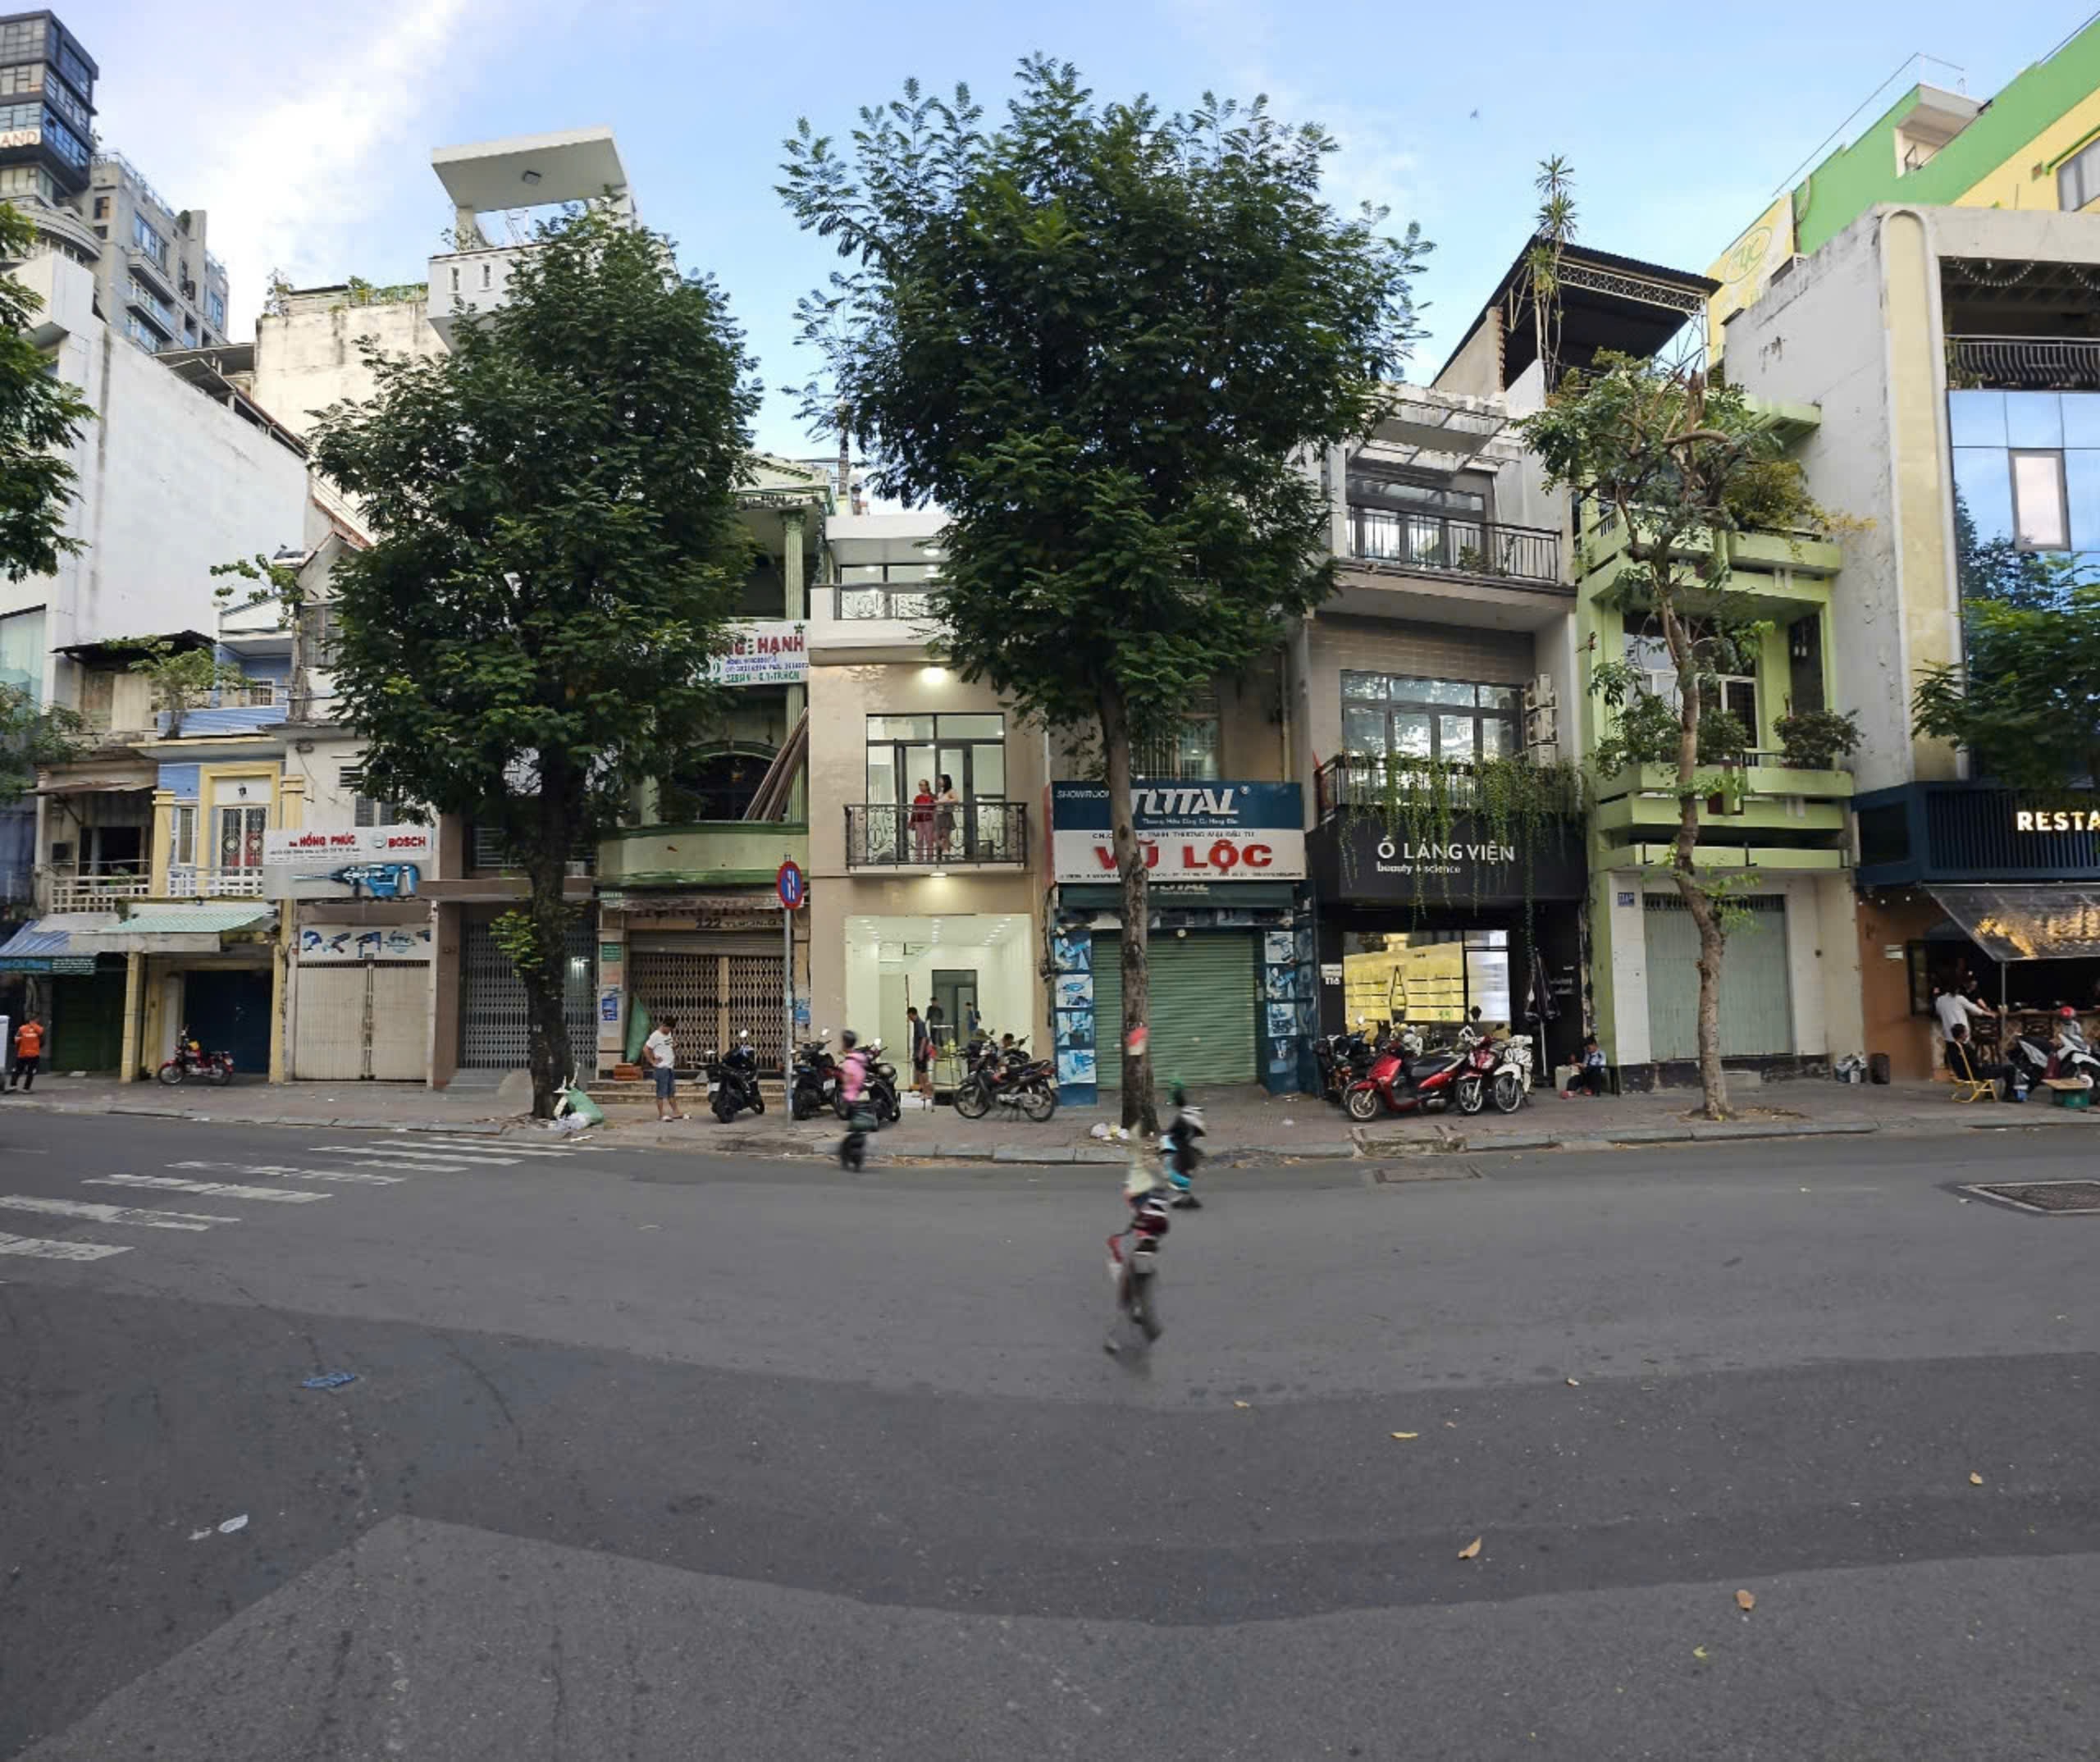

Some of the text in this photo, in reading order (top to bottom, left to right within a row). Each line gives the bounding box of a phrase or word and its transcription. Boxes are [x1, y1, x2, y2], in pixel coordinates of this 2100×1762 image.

[757, 636, 805, 655] HẠNH
[1130, 788, 1239, 815] TOTAL
[388, 836, 427, 847] BOSCH
[1182, 838, 1273, 874] LỘC
[1376, 861, 1413, 875] beauty
[1424, 865, 1461, 874] science
[696, 916, 722, 929] 122
[1325, 977, 1340, 985] 116
